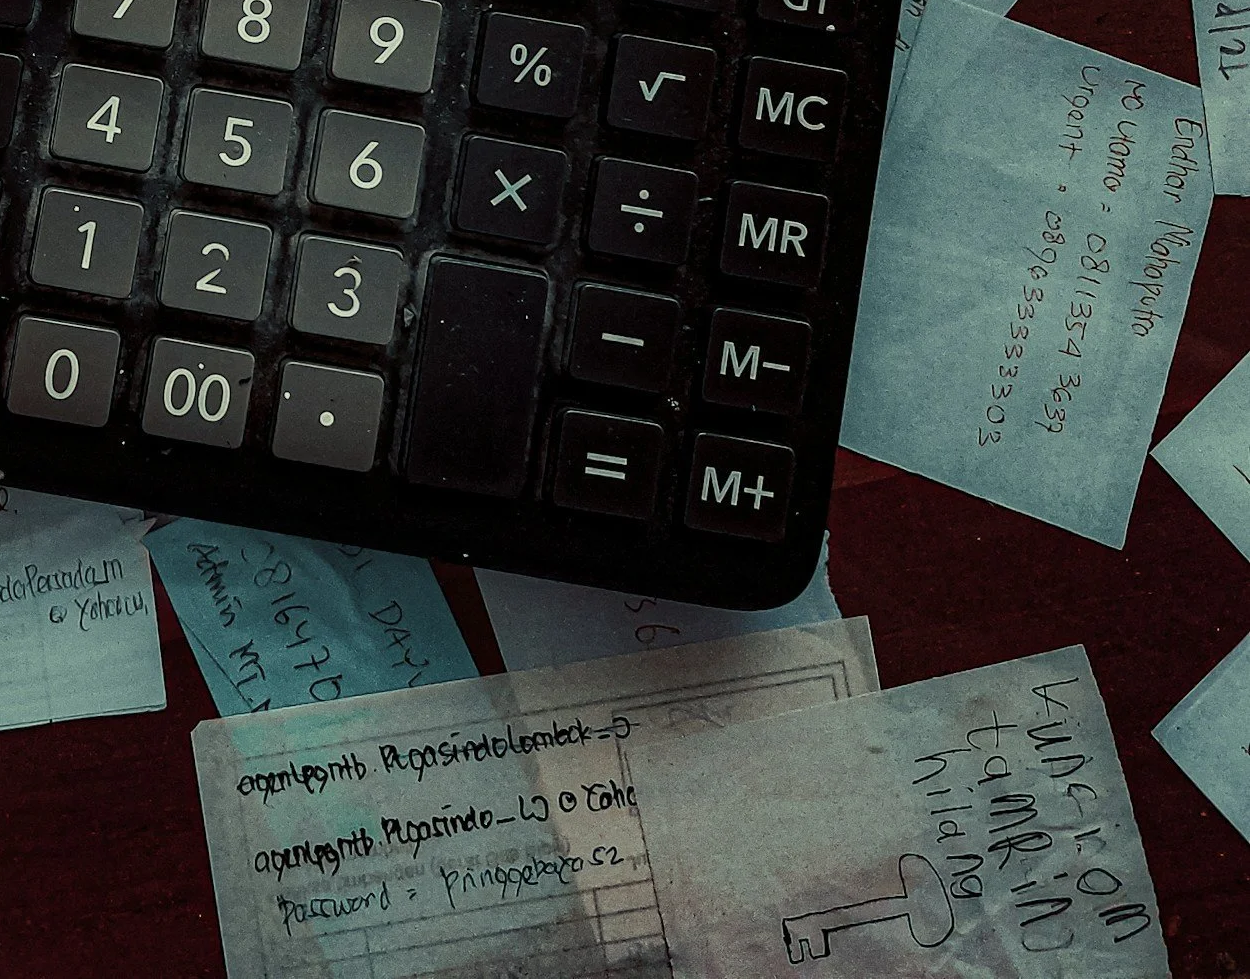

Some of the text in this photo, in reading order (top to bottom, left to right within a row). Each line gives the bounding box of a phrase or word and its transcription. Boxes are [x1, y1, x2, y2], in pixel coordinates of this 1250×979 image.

[370, 16, 404, 64] 9
[510, 43, 552, 86] %
[87, 95, 122, 143] 4
[755, 87, 829, 131] MC
[219, 116, 254, 166] 5
[349, 141, 383, 189] 6
[77, 221, 96, 269] 1
[738, 212, 808, 258] MR
[196, 243, 230, 294] 2
[327, 267, 362, 318] 3
[45, 349, 79, 400] 0
[164, 368, 231, 422] 00
[701, 466, 775, 510] M+
